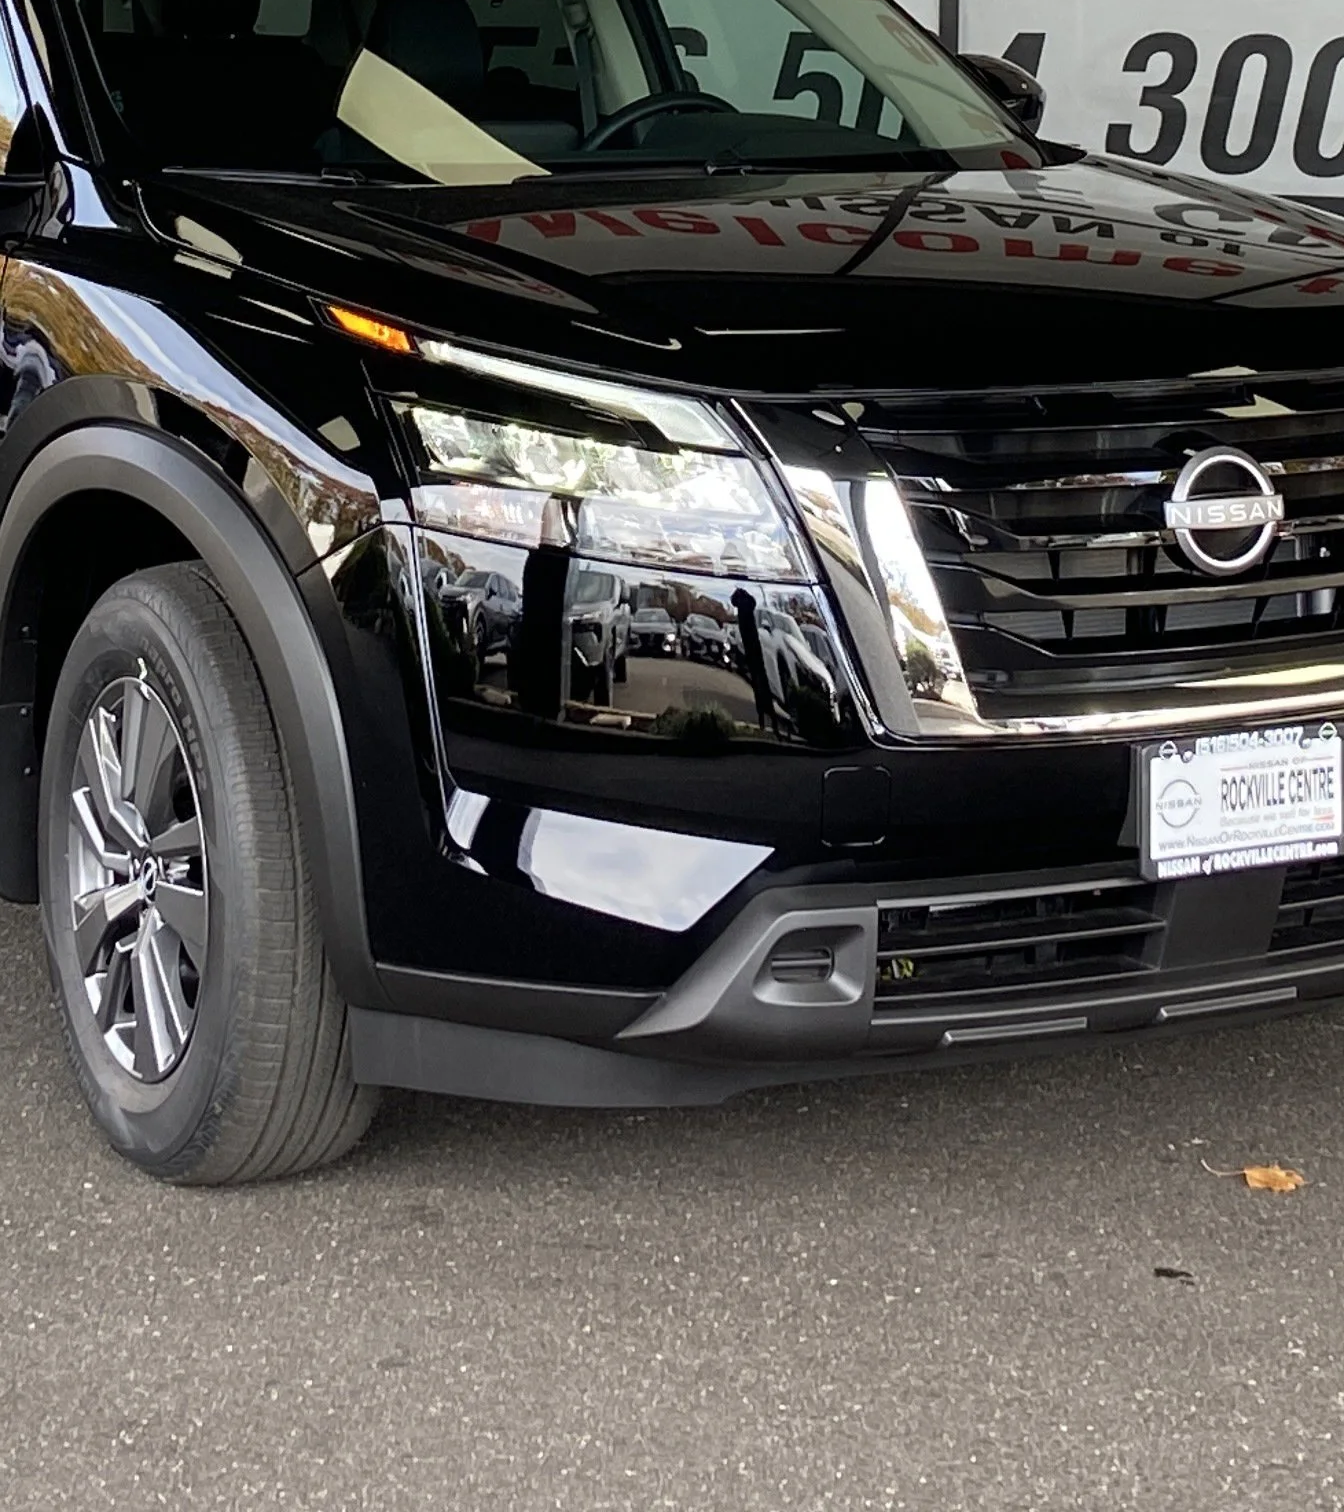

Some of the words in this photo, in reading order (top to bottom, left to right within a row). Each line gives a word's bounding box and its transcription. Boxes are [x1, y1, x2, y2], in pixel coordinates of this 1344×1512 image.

[1169, 499, 1282, 525] NISSAN
[1220, 771, 1285, 813] ROCKVILLE
[1288, 767, 1335, 804] CENTRE
[1156, 797, 1202, 812] NISSAN
[1158, 856, 1201, 879] NISSAN
